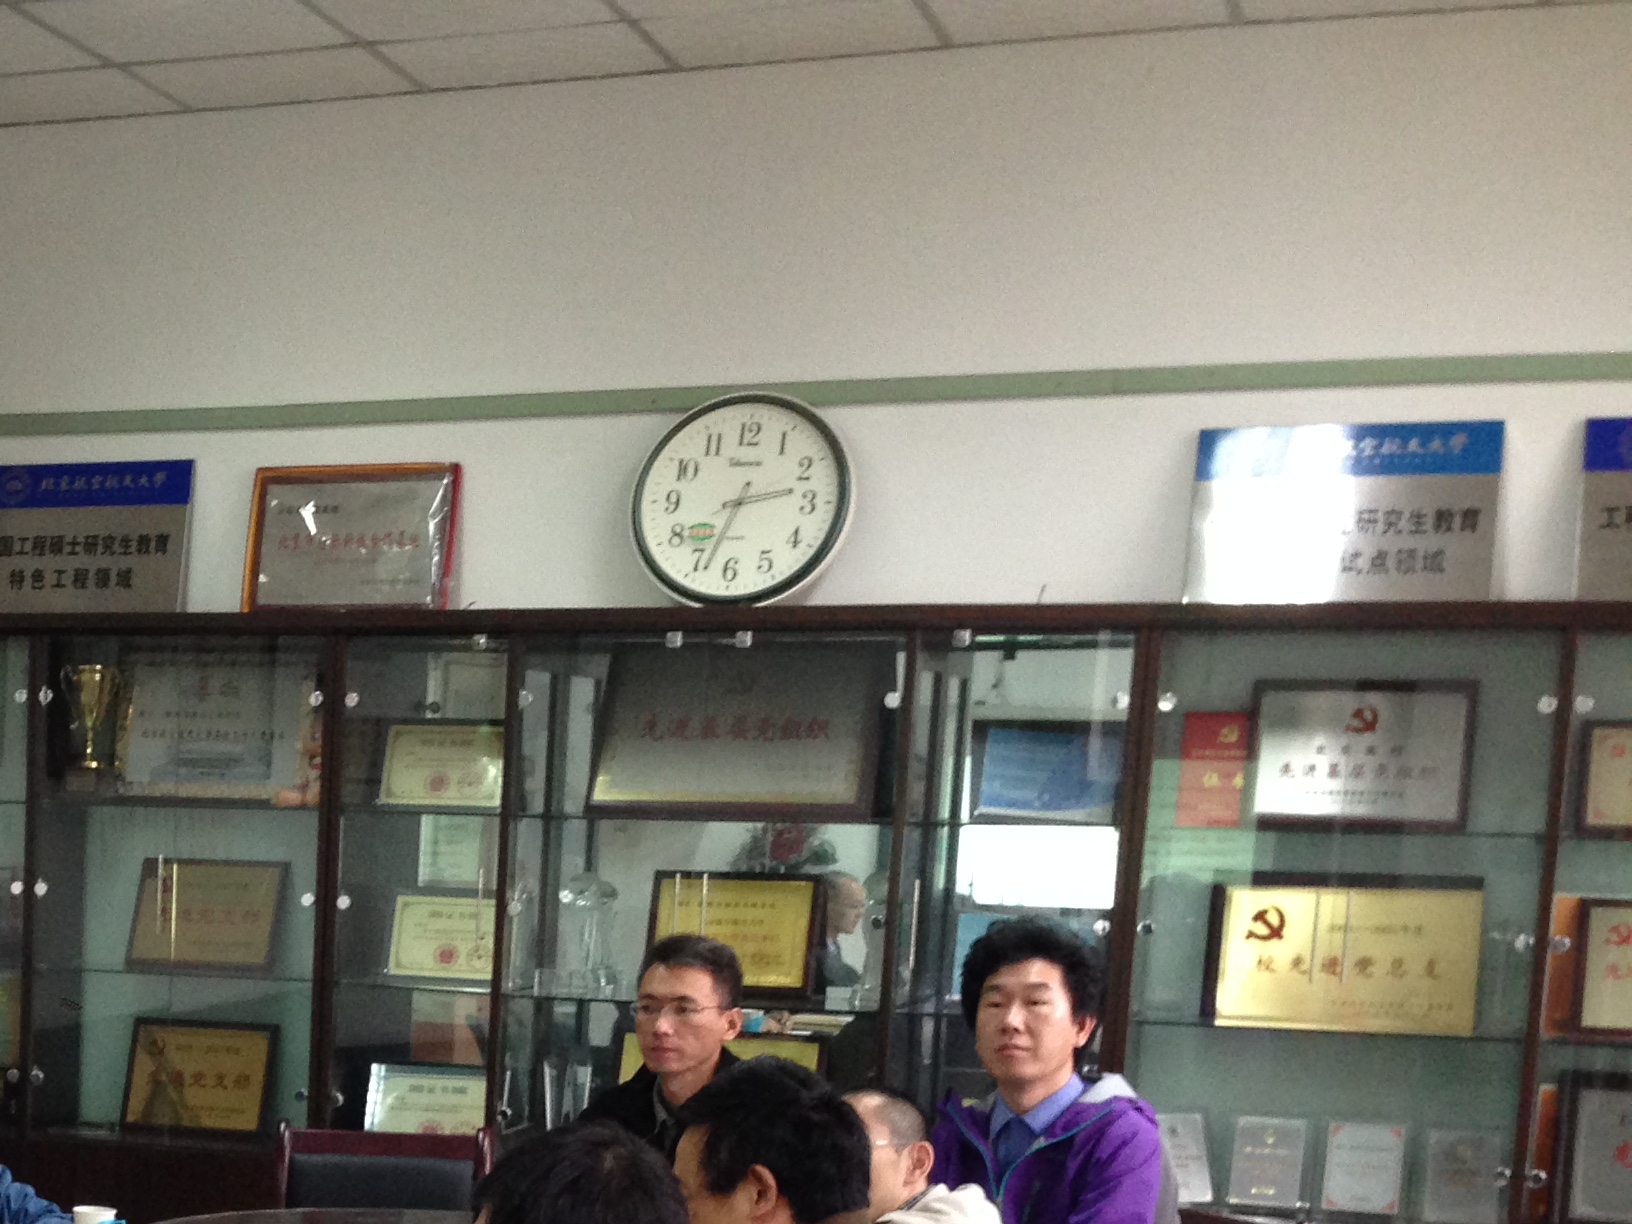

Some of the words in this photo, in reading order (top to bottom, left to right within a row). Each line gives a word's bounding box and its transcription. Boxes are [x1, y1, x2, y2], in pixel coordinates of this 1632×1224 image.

[704, 432, 723, 457] 11
[738, 421, 762, 447] 12
[778, 430, 788, 456] 1
[675, 457, 700, 482] 10
[796, 455, 814, 482] 2
[664, 489, 682, 515] 9
[799, 489, 817, 515] 3
[1341, 506, 1483, 537] 研究生教育
[668, 523, 685, 548] 8
[786, 525, 803, 549] 4
[690, 548, 706, 572] 7
[722, 557, 738, 582] 6
[757, 550, 774, 574] 5
[8, 567, 134, 591] 特色工程领域
